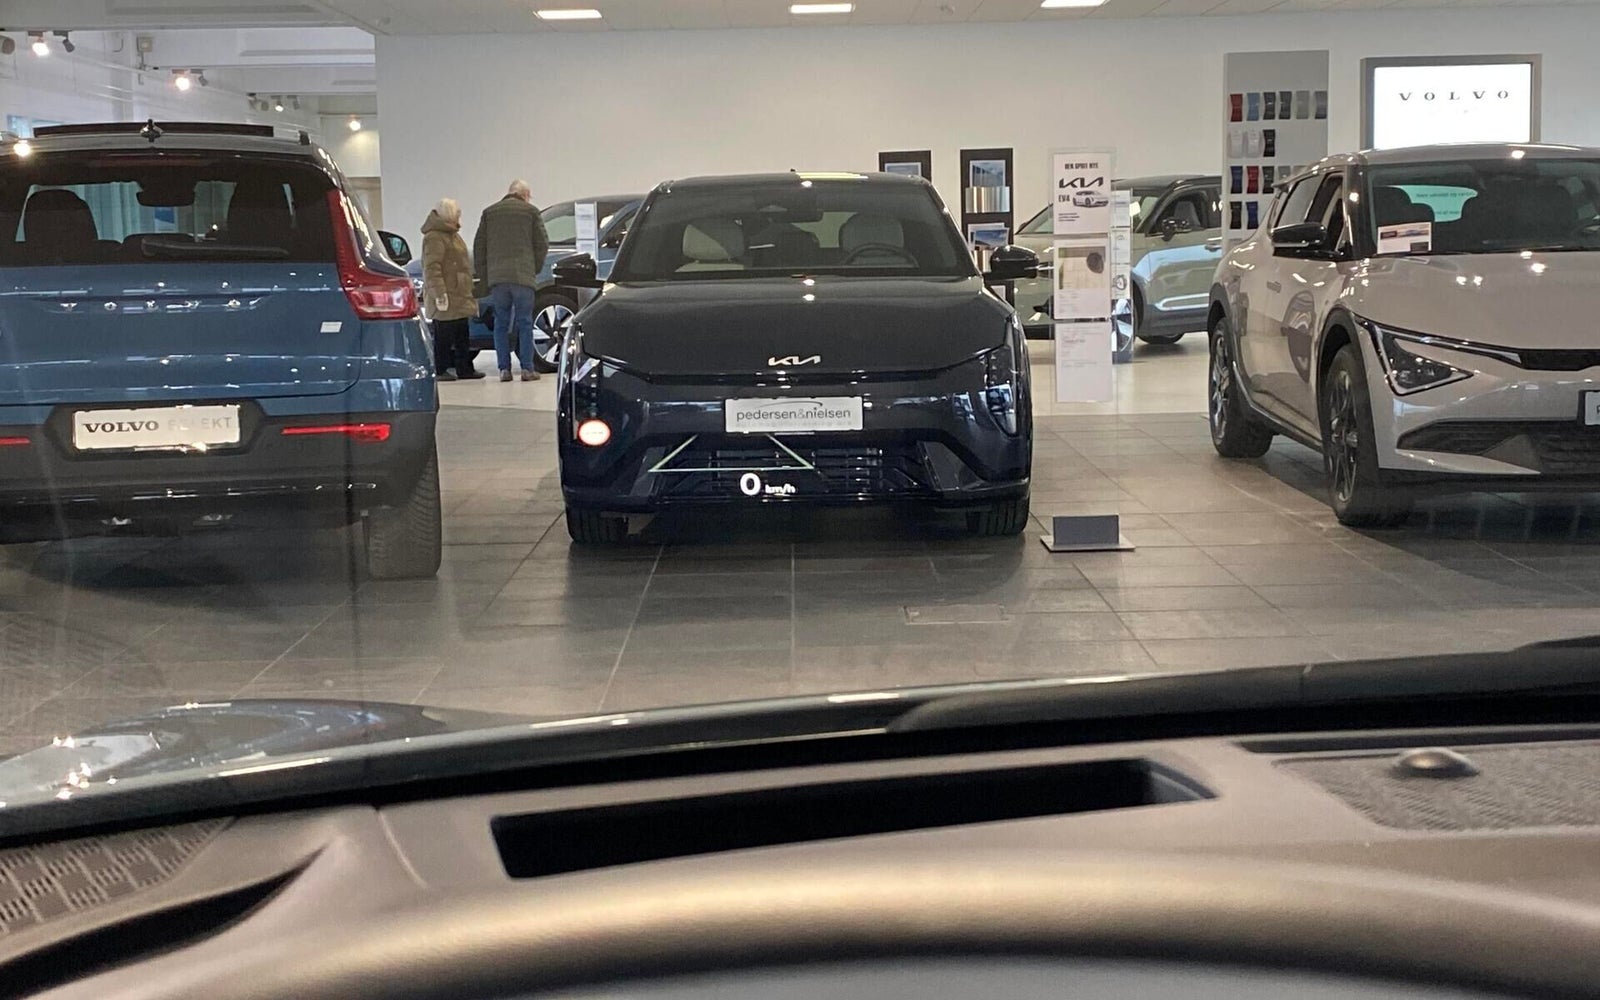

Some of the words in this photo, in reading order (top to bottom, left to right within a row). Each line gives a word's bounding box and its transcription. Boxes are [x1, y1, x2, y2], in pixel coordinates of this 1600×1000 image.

[1399, 90, 1509, 101] VOLVO
[1058, 176, 1104, 188] KIA
[768, 354, 821, 366] KIA
[736, 407, 851, 421] pedersen&nielsen
[82, 420, 159, 433] VOLVO
[740, 472, 761, 496] 0
